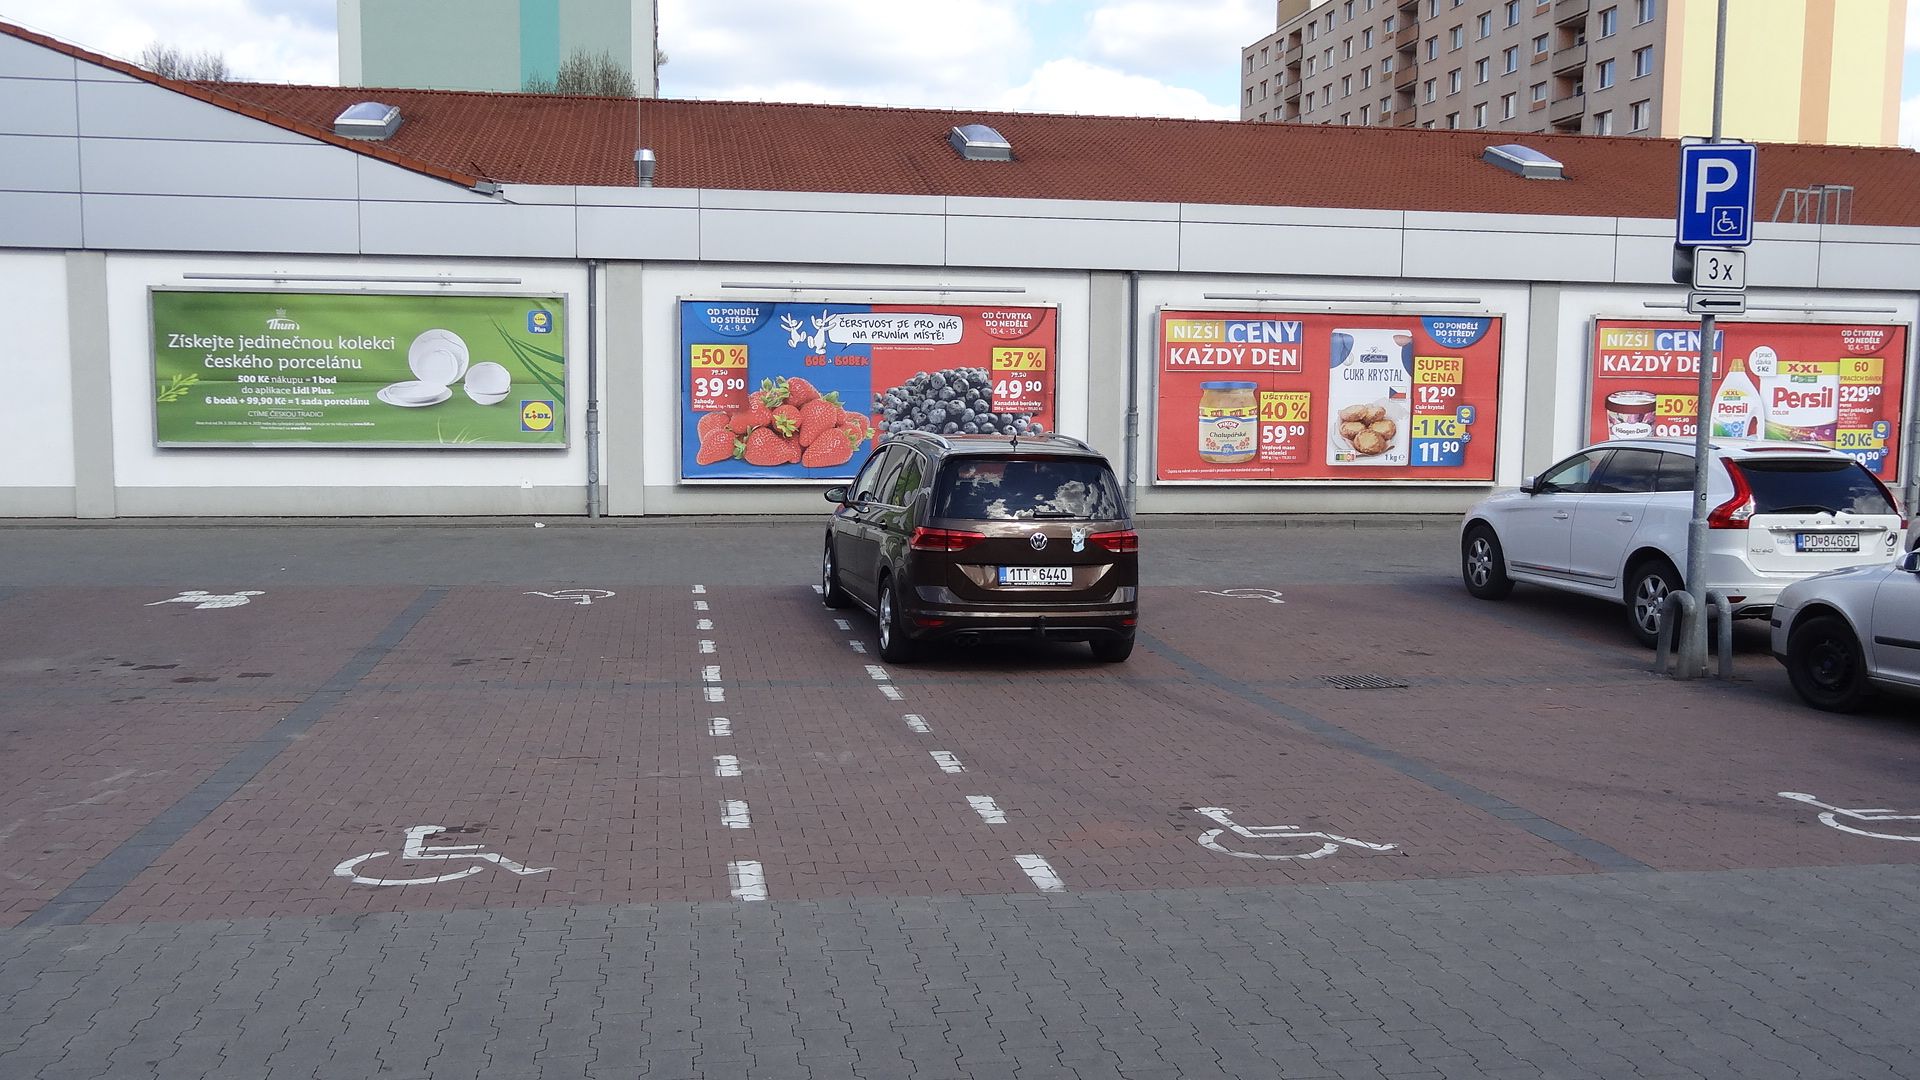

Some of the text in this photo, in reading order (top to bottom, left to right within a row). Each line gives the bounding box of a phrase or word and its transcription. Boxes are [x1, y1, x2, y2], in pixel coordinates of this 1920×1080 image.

[1696, 158, 1738, 213] P
[707, 307, 760, 316] OD PONDĚLÍ
[995, 311, 1032, 320] ČTVRTKA
[725, 316, 756, 324] STŘEDY
[839, 317, 958, 330] ČERSTVOST JE PRO NÁS
[999, 319, 1029, 328] NEDĚLE
[1446, 321, 1479, 330] PONDĚLÍ
[852, 328, 945, 341] NA PRVNÍM MÍSTĚ!
[1174, 321, 1299, 343] NIŽŠÍ CENY
[1448, 329, 1476, 338] STŘEDY
[1853, 329, 1884, 337] ČTVRTKA
[168, 334, 395, 352] Získejte jedinečnou kolekci
[1607, 331, 1648, 347] NIŽŠÍ
[693, 349, 745, 365] -50 %
[805, 355, 826, 367] BOB
[995, 352, 1042, 368] -37 %
[1170, 344, 1297, 366] KAŽDÝ DEN
[205, 354, 362, 371] českého porcelánu
[1417, 359, 1460, 371] SUPER
[1603, 352, 1672, 372] KAŽDÝ
[1787, 363, 1822, 374] XXL
[1854, 362, 1869, 372] 60
[238, 375, 256, 383] 500
[258, 375, 270, 383] Kč
[271, 376, 303, 385] nákupu
[312, 376, 317, 384] 1
[319, 376, 337, 384] bod
[1343, 368, 1404, 382] CUKR KRYSTAL
[1422, 372, 1456, 383] CENA
[241, 386, 335, 395] do aplikace Lidl Plus.
[1772, 386, 1833, 408] Persil
[205, 397, 212, 405] 6
[213, 396, 238, 405] bodů
[247, 397, 273, 406] 99,90
[274, 397, 287, 405] Kč
[301, 397, 323, 406] sada
[324, 397, 370, 407] porcelánu
[1657, 399, 1684, 413] -50
[1261, 402, 1287, 419] 40
[1291, 402, 1307, 419] %
[1718, 403, 1748, 414] Persil
[1413, 420, 1456, 436] -1 Kč
[1837, 433, 1872, 446] -30 Kč
[1805, 535, 1818, 547] PD
[1823, 535, 1857, 547] 846GZ
[1009, 568, 1030, 581] 1TT
[1039, 568, 1067, 581] 6440
